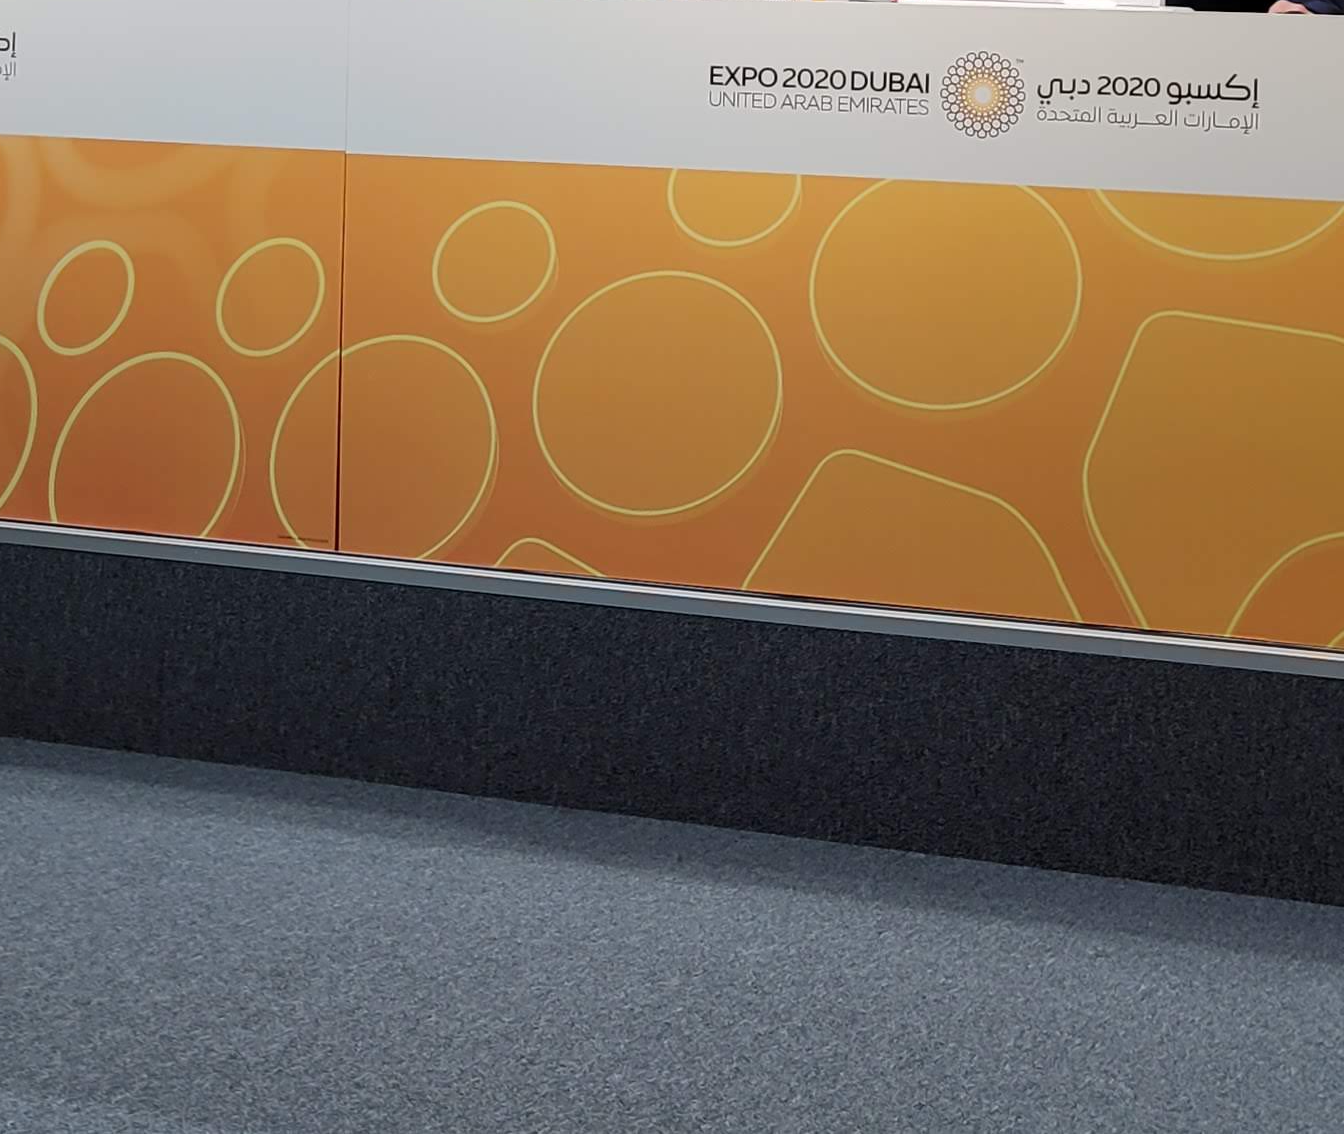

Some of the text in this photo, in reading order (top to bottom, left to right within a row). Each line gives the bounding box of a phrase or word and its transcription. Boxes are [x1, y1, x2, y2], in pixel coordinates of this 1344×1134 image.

[710, 66, 929, 93] EXPO 2020 DUBAI
[1038, 74, 1258, 108] إكسبو 2020 دبي
[710, 91, 928, 115] UNITED ARAB EMIRATES
[1037, 106, 1258, 134] الإمارات العربية المتحدة
